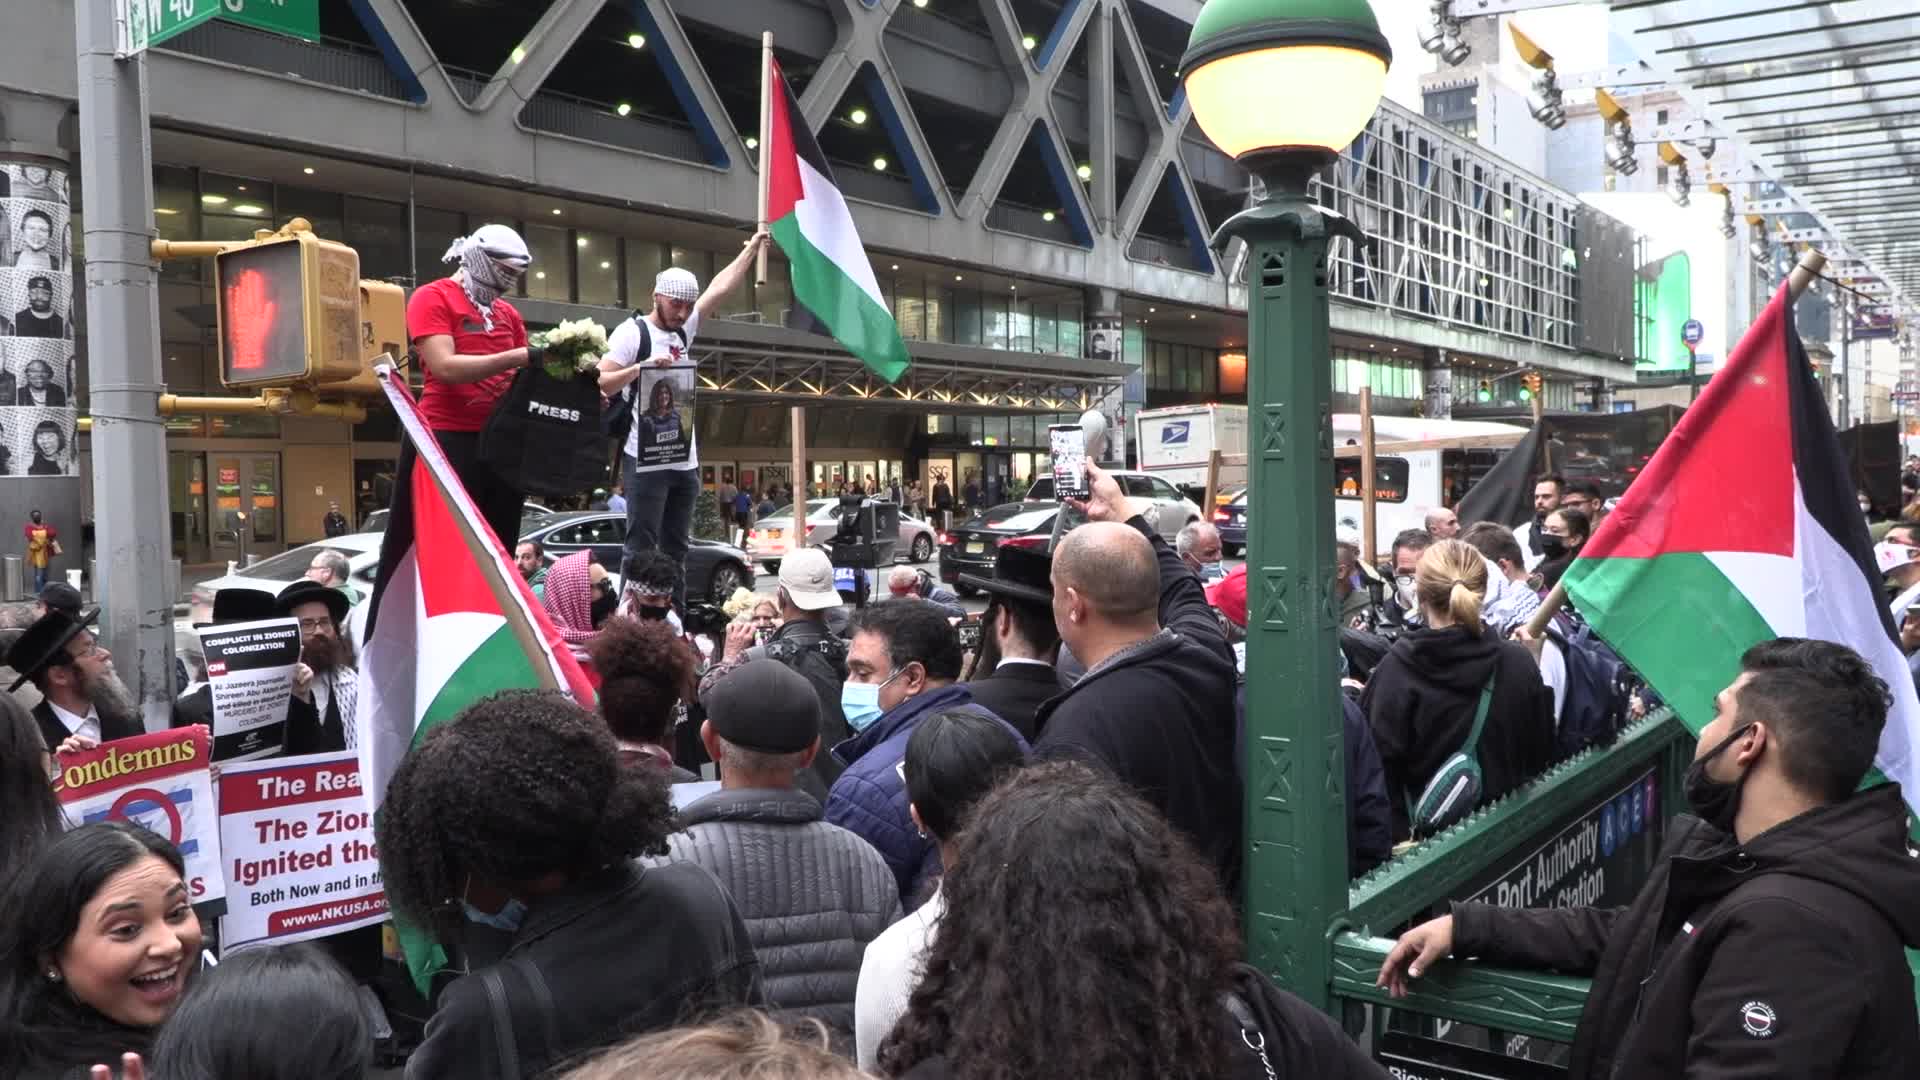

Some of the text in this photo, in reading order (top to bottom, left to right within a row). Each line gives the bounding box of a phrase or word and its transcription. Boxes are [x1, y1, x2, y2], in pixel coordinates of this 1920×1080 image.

[528, 400, 580, 421] PRESS
[205, 630, 296, 647] COMPLICIT IN ZIONIST
[222, 641, 285, 655] COLONIZATION
[215, 691, 245, 701] Shireen
[246, 689, 260, 697] Abu
[224, 680, 255, 690] Jazeera
[53, 738, 196, 792] ondemns
[257, 776, 306, 800] The
[254, 818, 308, 844] The
[233, 843, 333, 886] Ignited
[1497, 865, 1532, 909] Port
[1535, 818, 1599, 899] Authority
[251, 887, 285, 906] Both
[289, 883, 320, 900] Now
[324, 876, 351, 893] and
[355, 874, 368, 889] in
